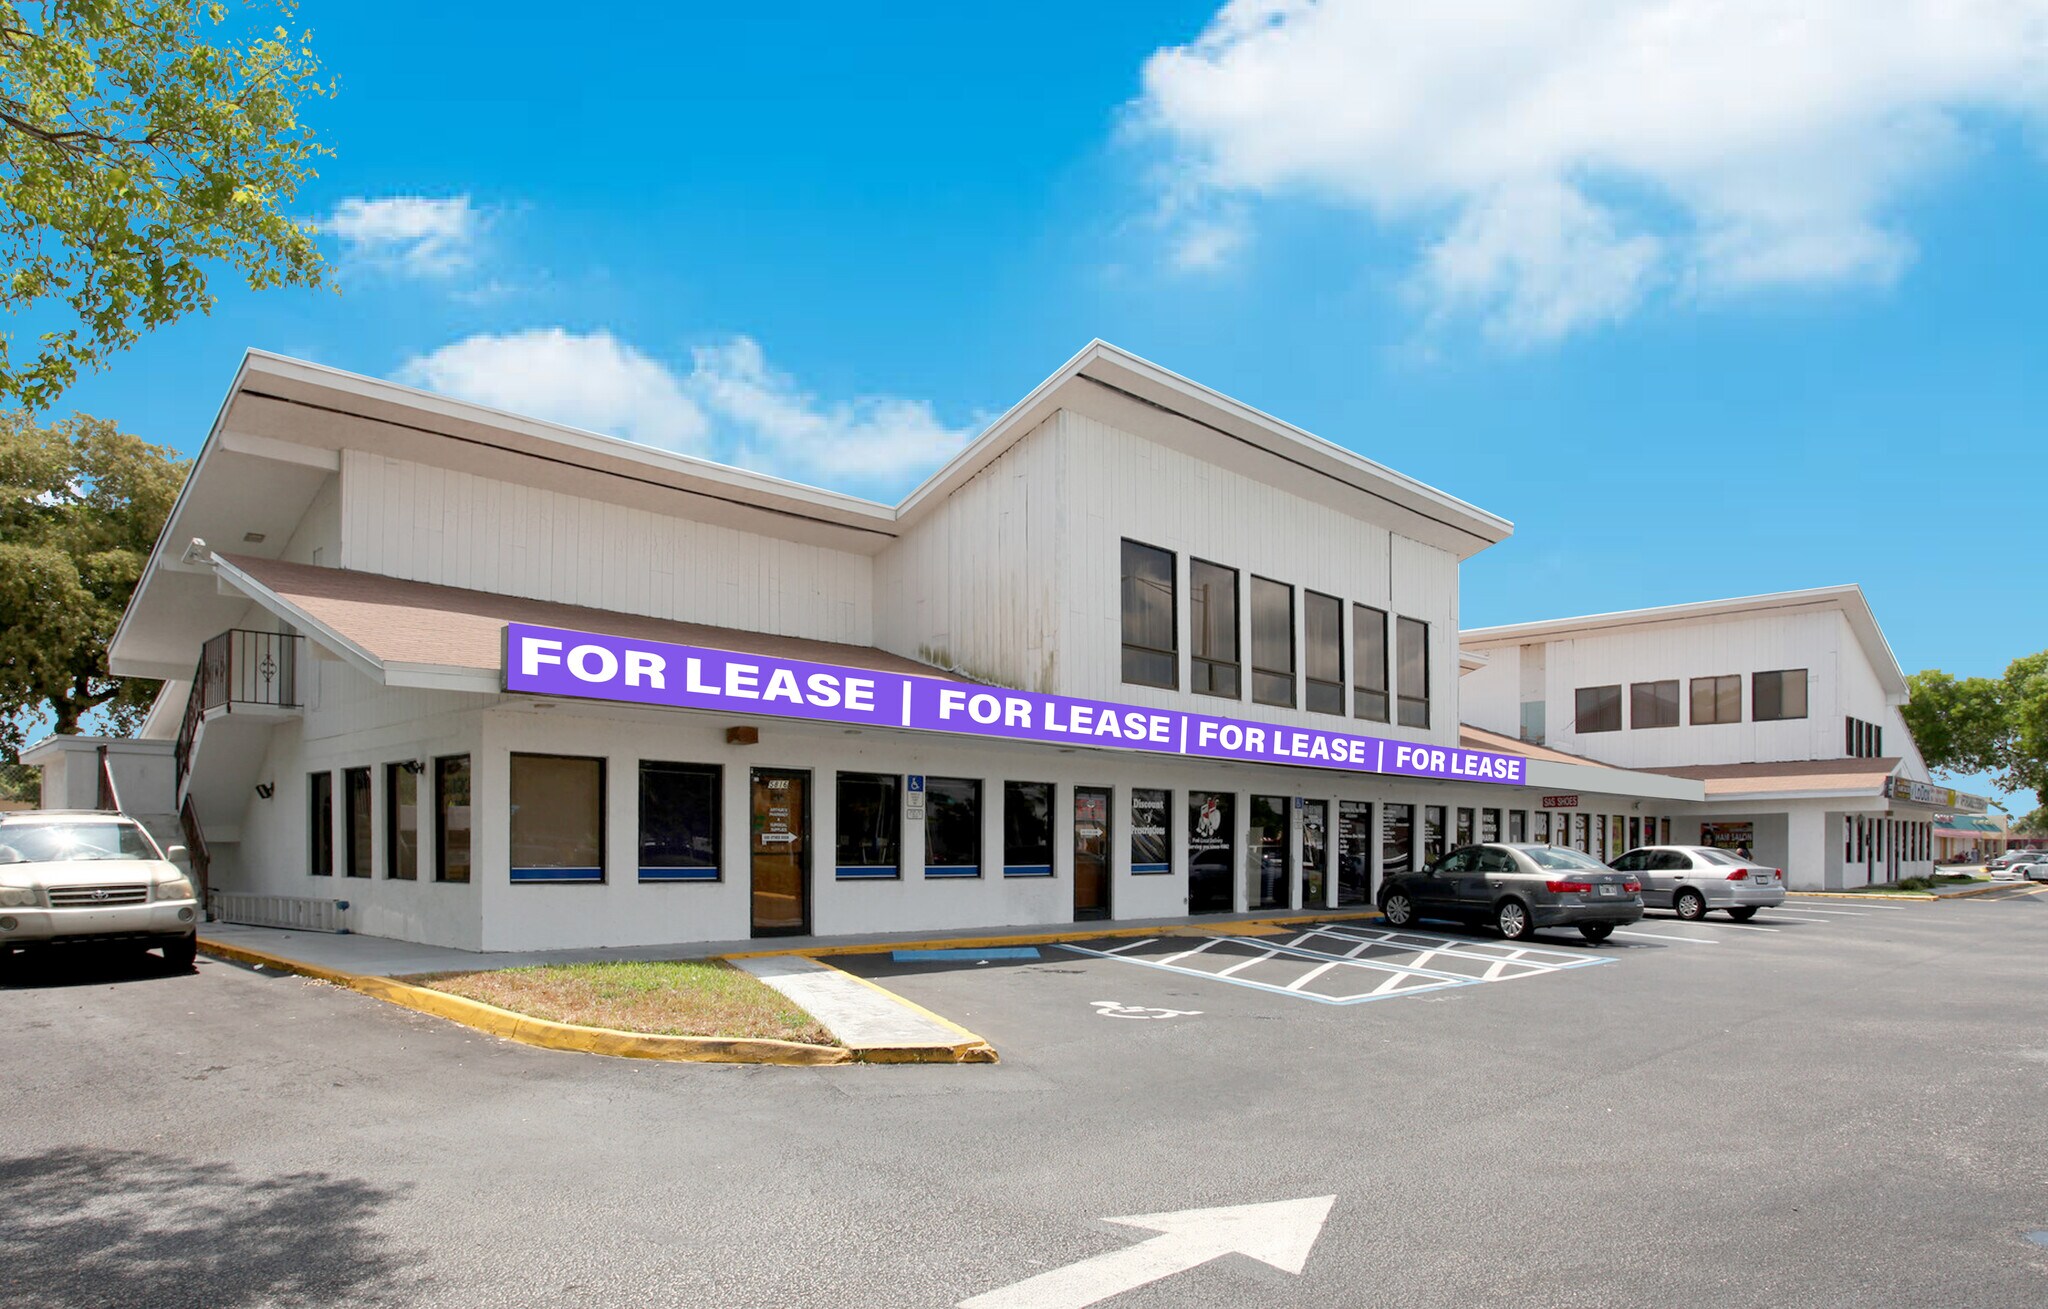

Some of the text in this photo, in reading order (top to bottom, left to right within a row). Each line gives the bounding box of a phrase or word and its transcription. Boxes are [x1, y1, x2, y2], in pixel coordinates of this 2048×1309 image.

[521, 637, 875, 712] FOR LEASE
[939, 689, 1170, 743] FOR LEASE
[1198, 721, 1365, 764] FOR LEASE
[1396, 746, 1520, 780] FOR LEASE
[1133, 798, 1164, 809] Discount
[1543, 796, 1577, 807] SAS SHOES
[1131, 825, 1165, 836] Prescriptions
